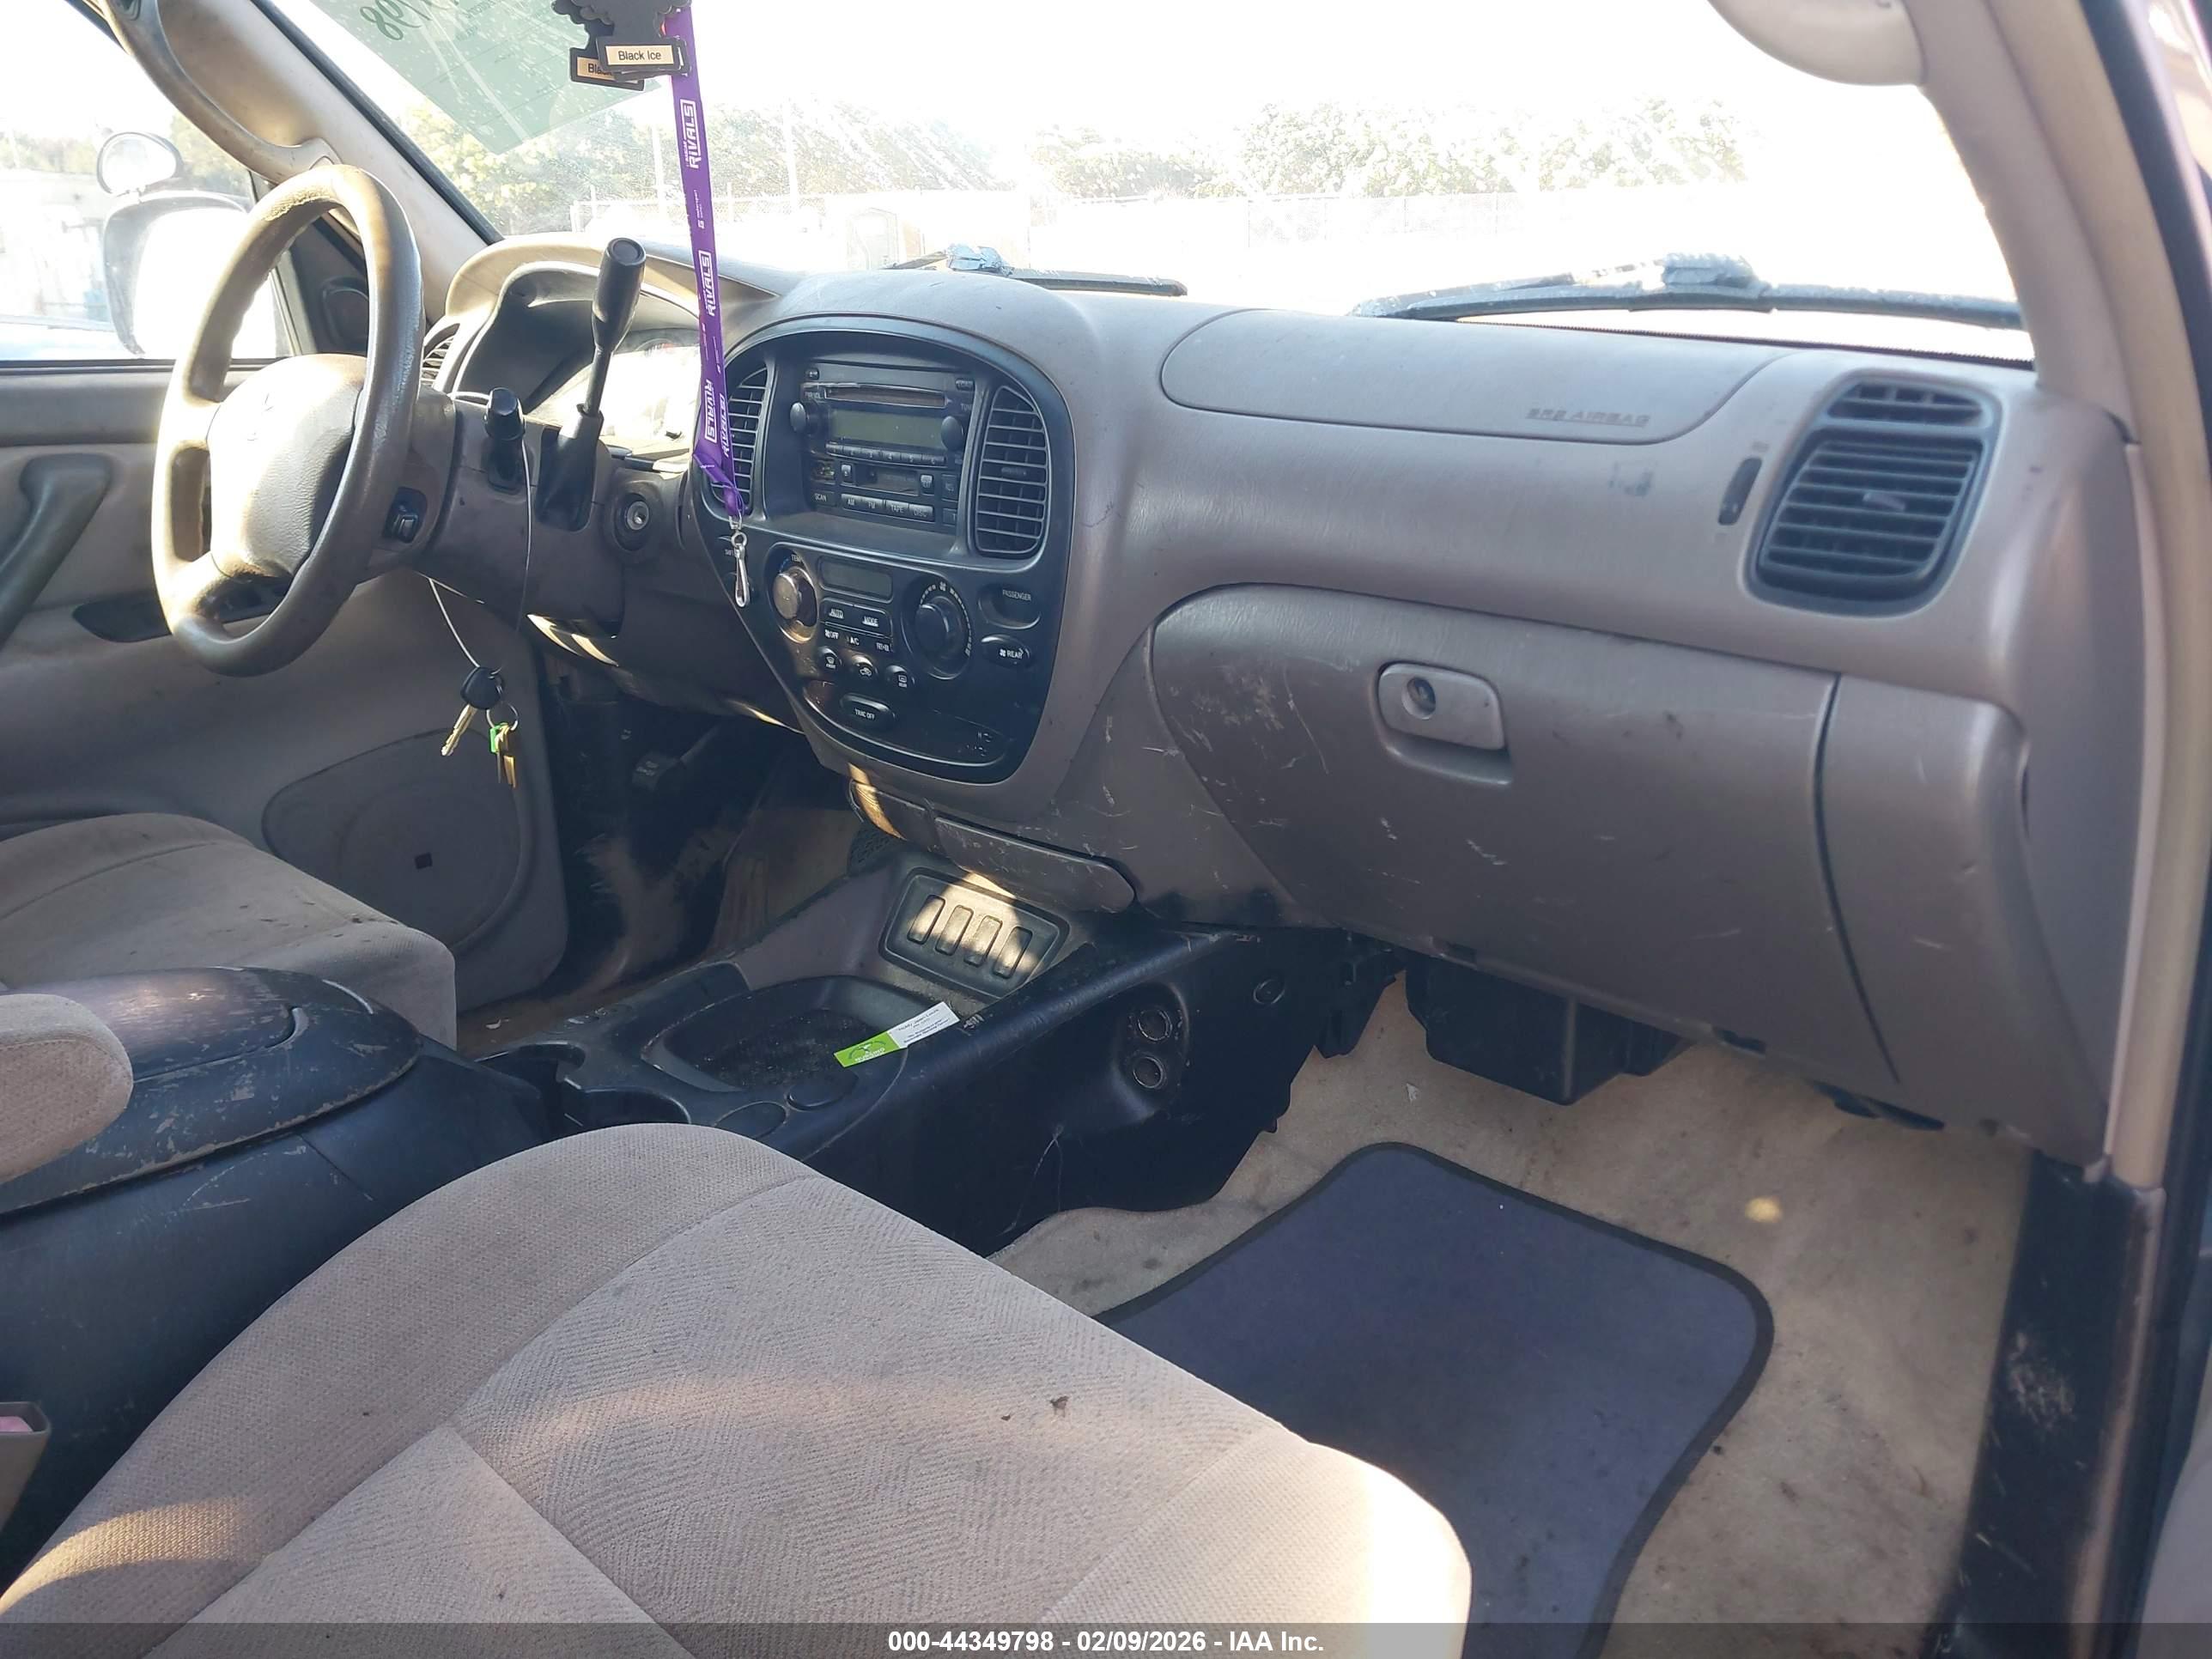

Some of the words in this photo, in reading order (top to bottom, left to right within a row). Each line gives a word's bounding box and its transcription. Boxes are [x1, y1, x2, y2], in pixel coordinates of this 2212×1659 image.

[618, 51, 645, 60] Black
[647, 51, 661, 60] Ice
[1571, 410, 1650, 426] AIRBAG
[814, 493, 827, 502] SCAN
[1002, 589, 1031, 601] PASSENGER
[1006, 649, 1023, 659] REAR
